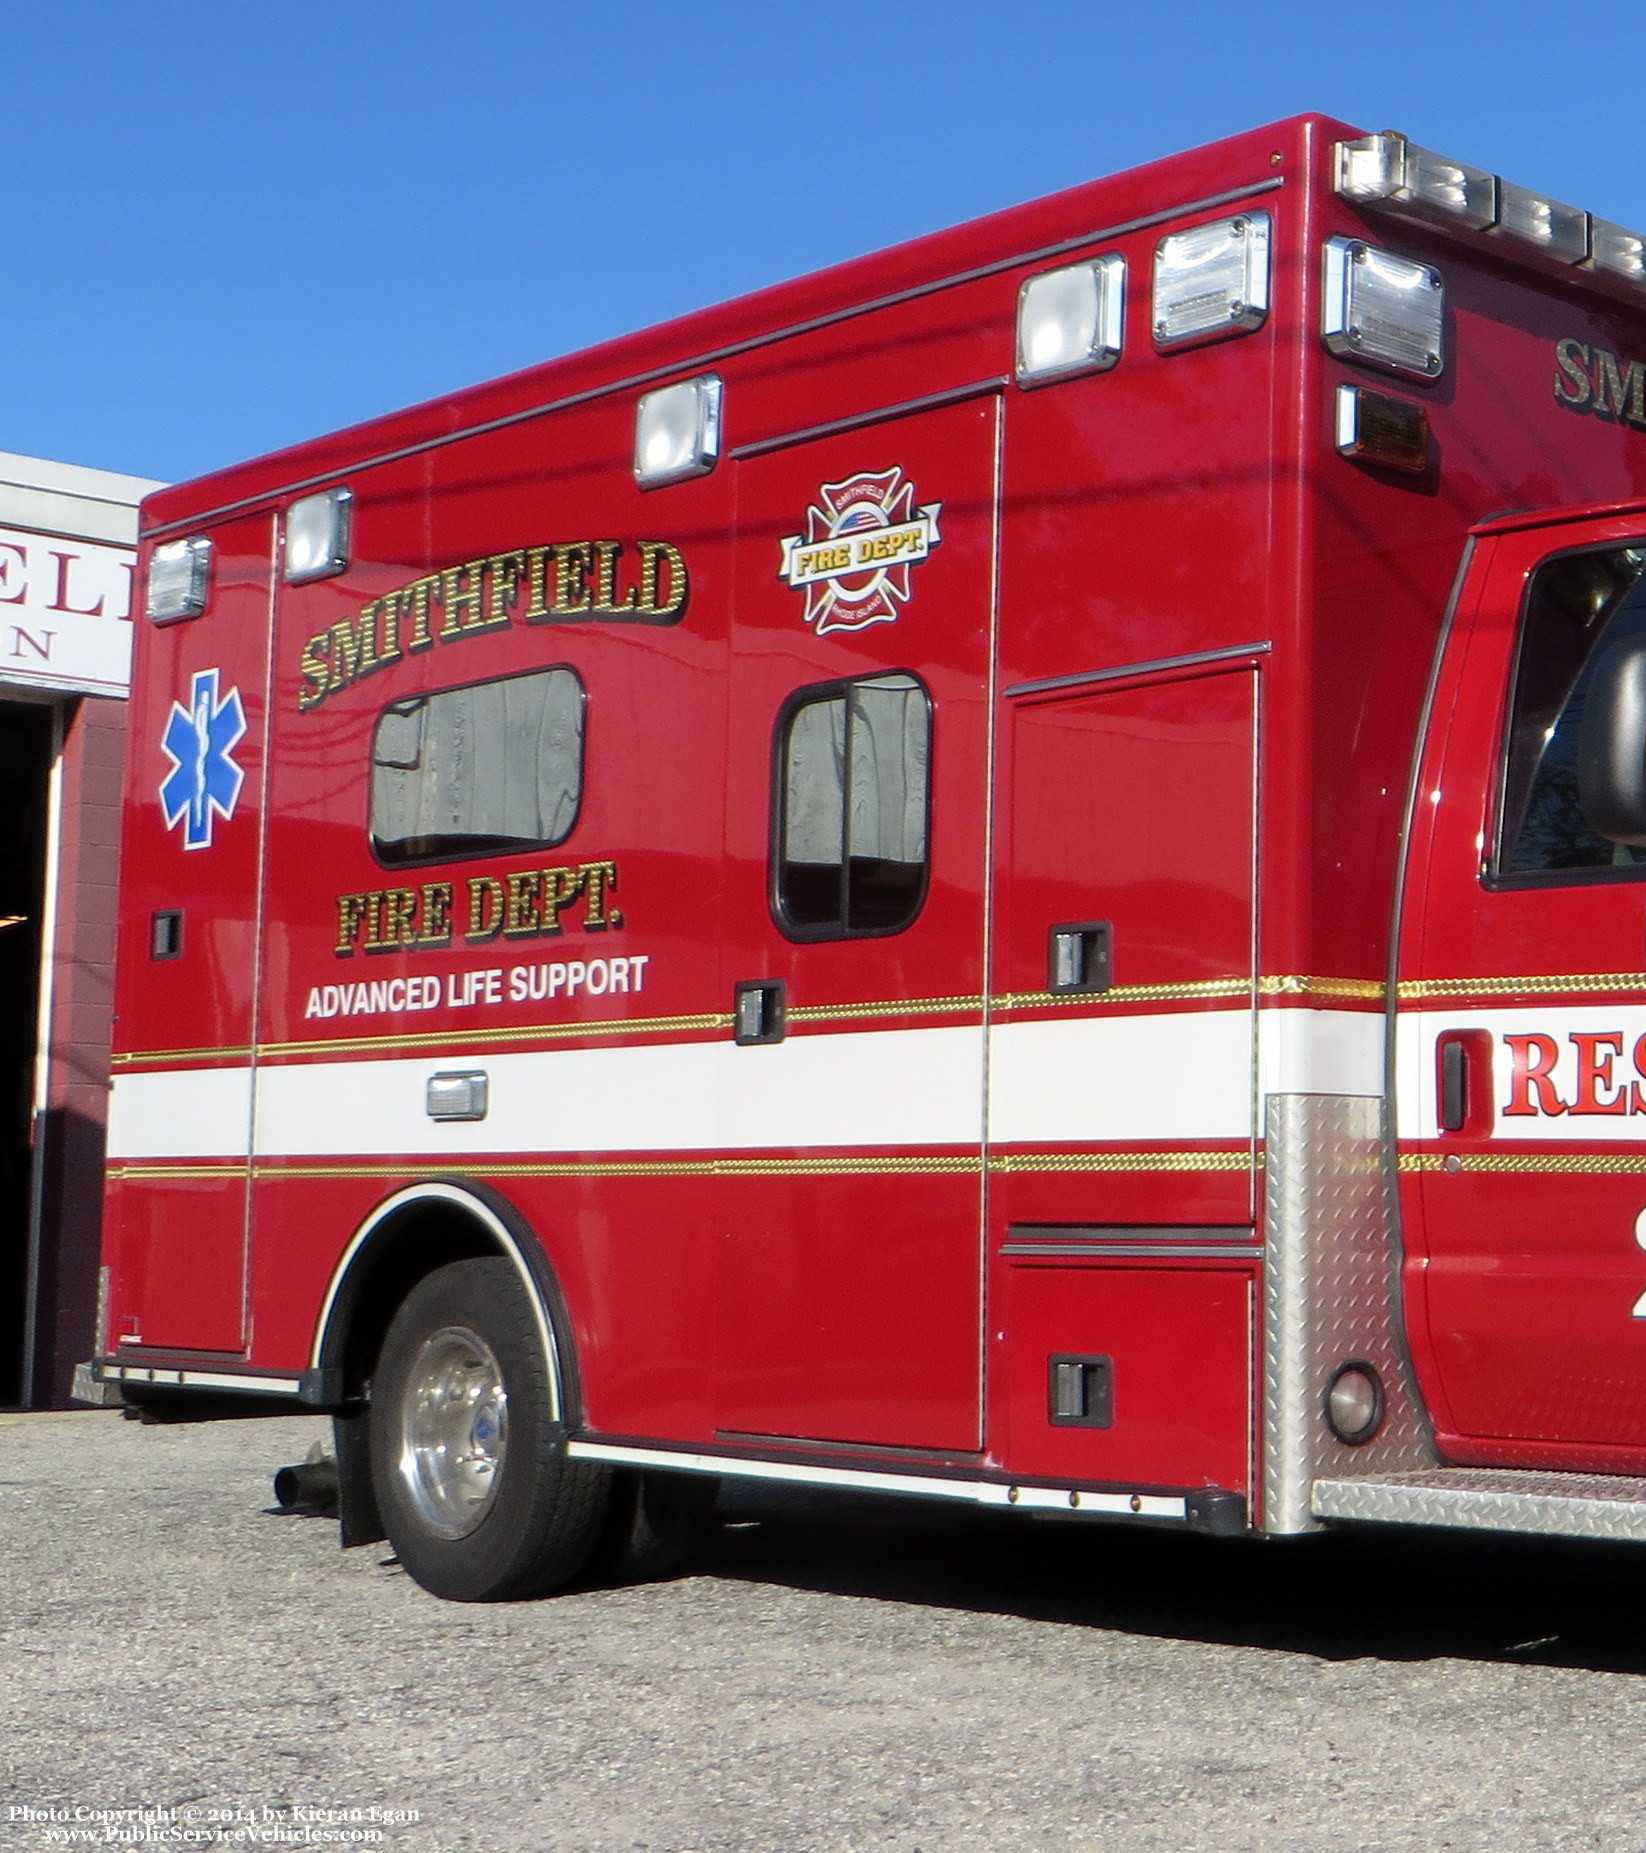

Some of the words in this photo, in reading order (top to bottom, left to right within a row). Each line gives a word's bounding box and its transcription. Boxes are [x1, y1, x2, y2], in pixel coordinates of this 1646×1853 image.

[835, 484, 884, 510] SMITHFIELD
[797, 543, 850, 577] FIRE
[857, 528, 924, 565] DEPT.
[299, 539, 689, 714] SMITHFIELD
[333, 882, 453, 958] FIRE
[463, 861, 625, 941] DEPT.
[305, 974, 440, 1019] ADVANCED
[447, 967, 502, 1009] LIFE
[509, 955, 649, 1003] SUPPORT
